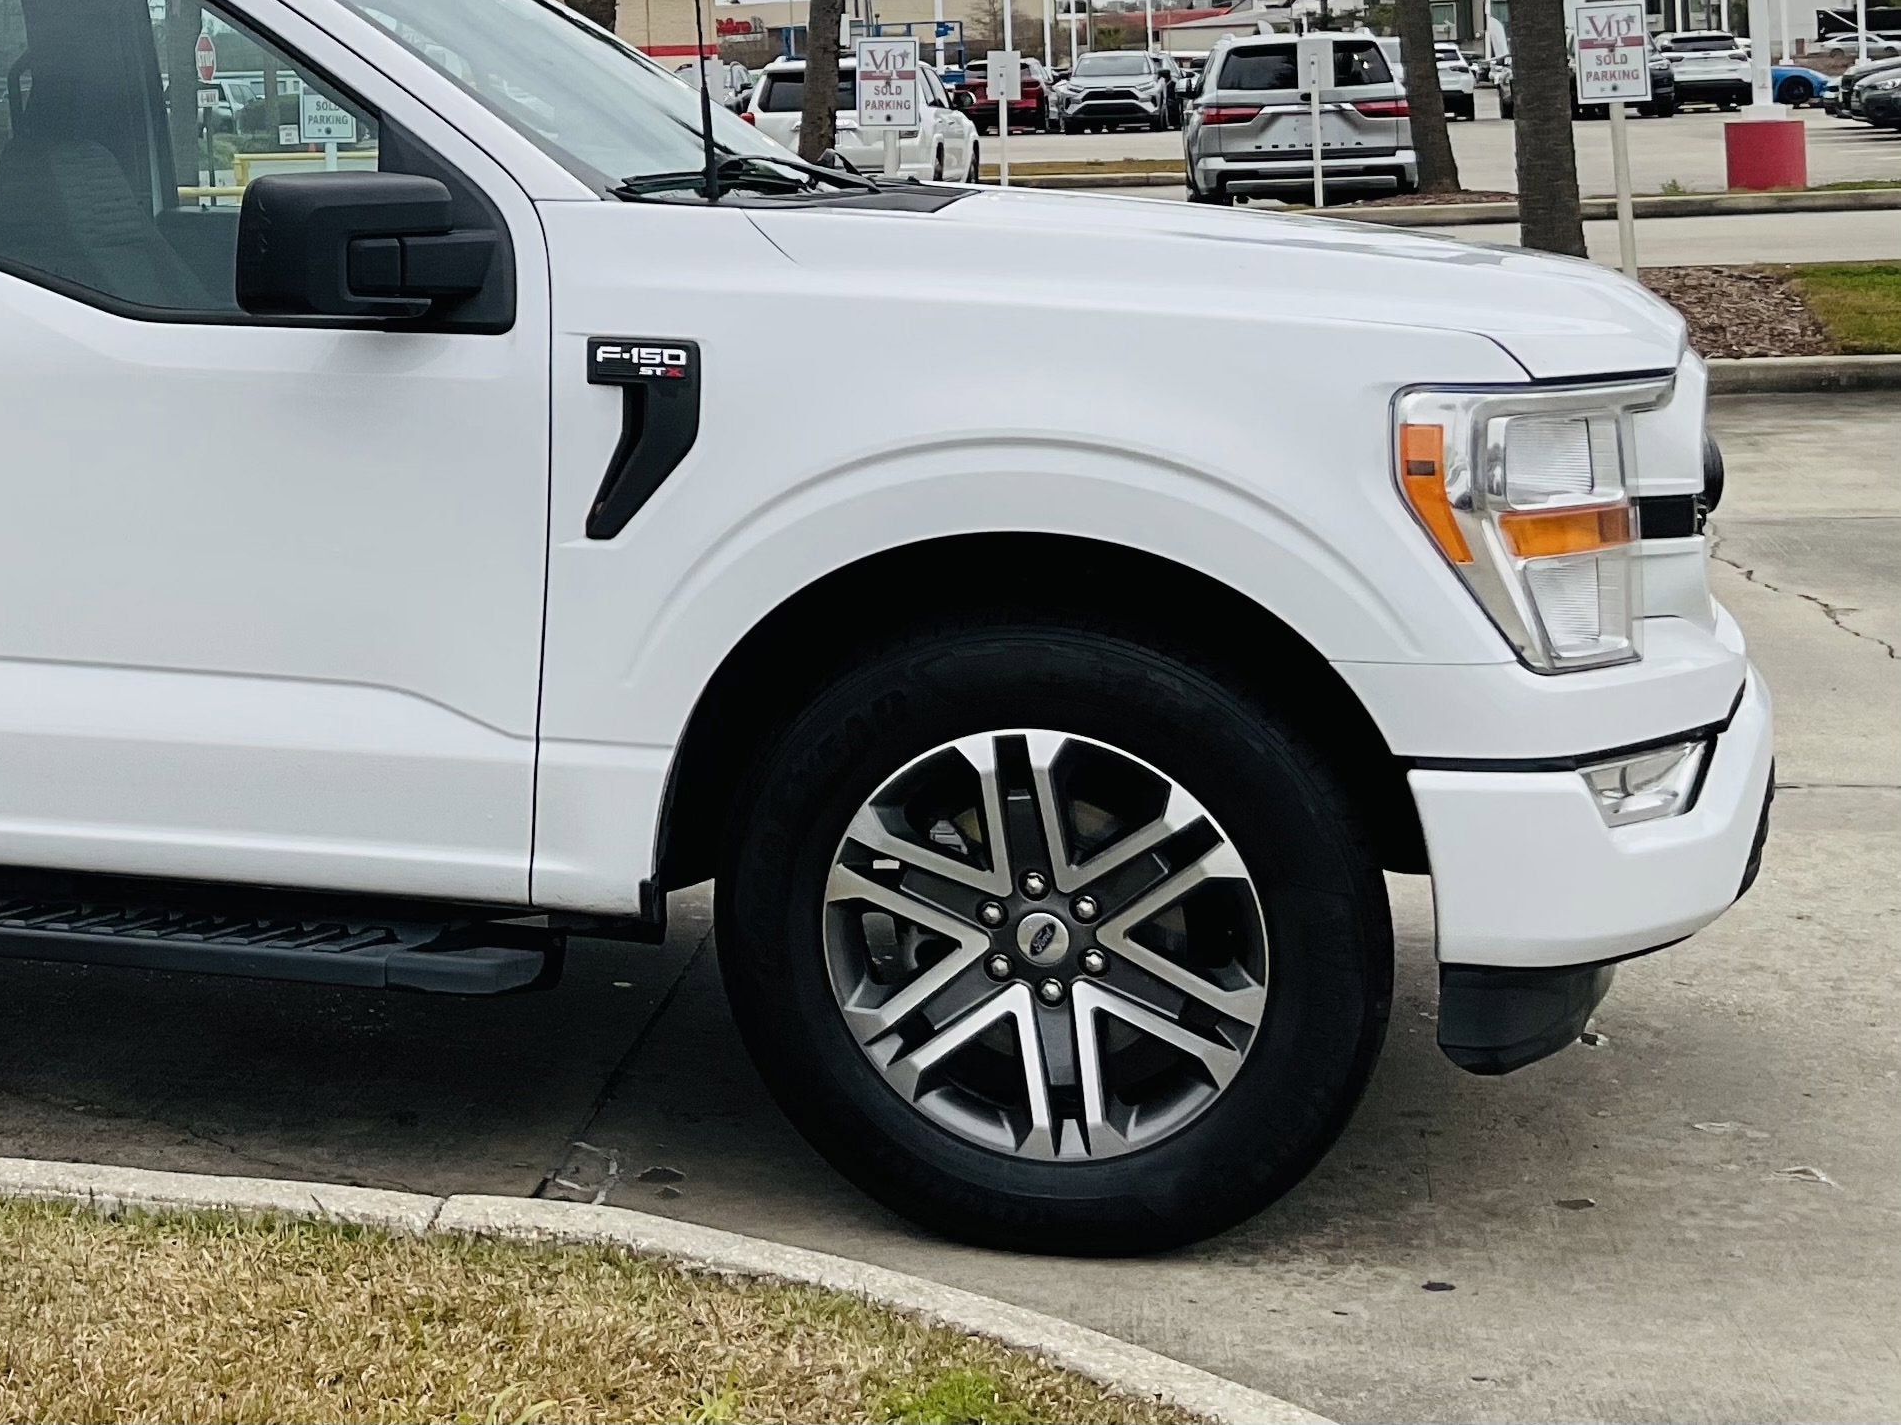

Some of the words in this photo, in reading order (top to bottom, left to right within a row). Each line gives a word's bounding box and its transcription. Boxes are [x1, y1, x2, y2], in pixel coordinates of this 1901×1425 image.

[1595, 54, 1628, 66] SOLD
[1586, 69, 1639, 82] PARKING
[874, 85, 902, 96] SOLD
[865, 100, 911, 110] PARKING
[307, 114, 349, 125] PARKING
[596, 346, 687, 365] F-150
[638, 366, 684, 377] STX
